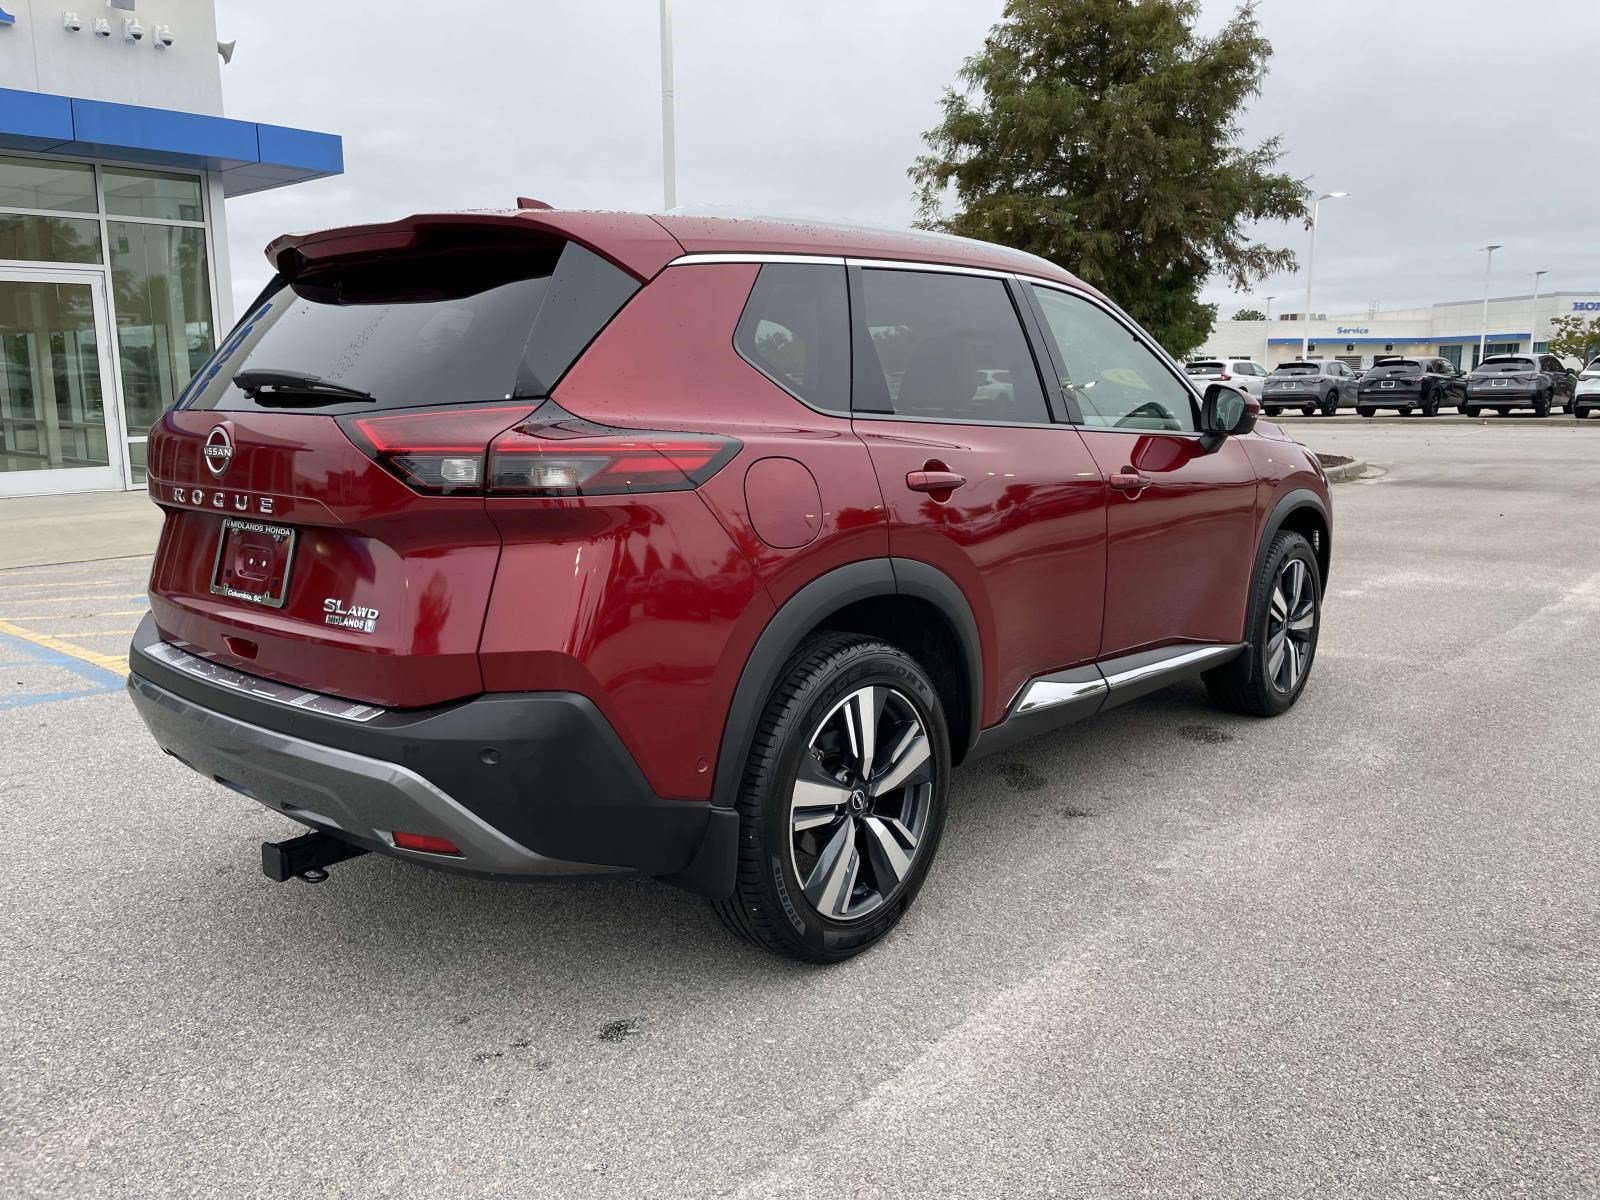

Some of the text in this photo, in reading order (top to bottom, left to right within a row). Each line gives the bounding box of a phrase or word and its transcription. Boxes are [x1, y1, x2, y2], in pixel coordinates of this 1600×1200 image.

[1337, 326, 1369, 334] Service
[204, 447, 231, 456] NISSAN
[174, 488, 273, 513] ROGUE
[230, 520, 290, 536] MIDLANDS HONDA
[253, 594, 262, 603] SC
[323, 598, 379, 620] SL AWD
[325, 614, 364, 629] MIDLANDS
